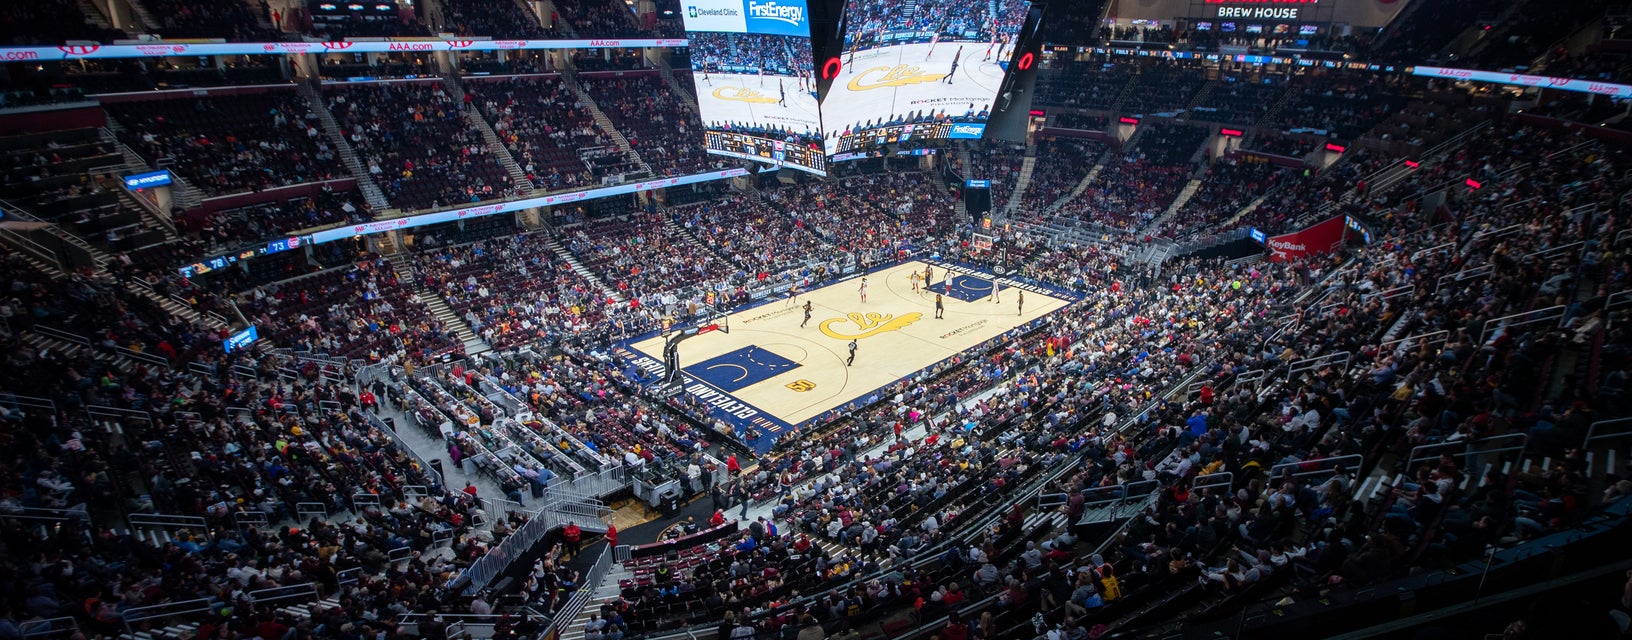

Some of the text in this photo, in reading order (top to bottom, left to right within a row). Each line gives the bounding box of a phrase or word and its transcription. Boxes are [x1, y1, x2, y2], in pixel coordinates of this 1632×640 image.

[749, 1, 802, 21] FirstEnergy
[1218, 7, 1298, 18] BREW HOUSE
[389, 42, 432, 51] AAA.com
[1439, 68, 1472, 78] AAA.com
[1589, 84, 1620, 94] AAA.com
[911, 97, 947, 105] ROCKET
[774, 151, 783, 160] 73
[272, 242, 284, 251] 73
[1268, 240, 1306, 251] KeyBank
[211, 259, 223, 268] 78
[939, 262, 996, 279] CLEVELAND
[783, 379, 817, 393] 50
[685, 383, 758, 420] CLEVELAND
